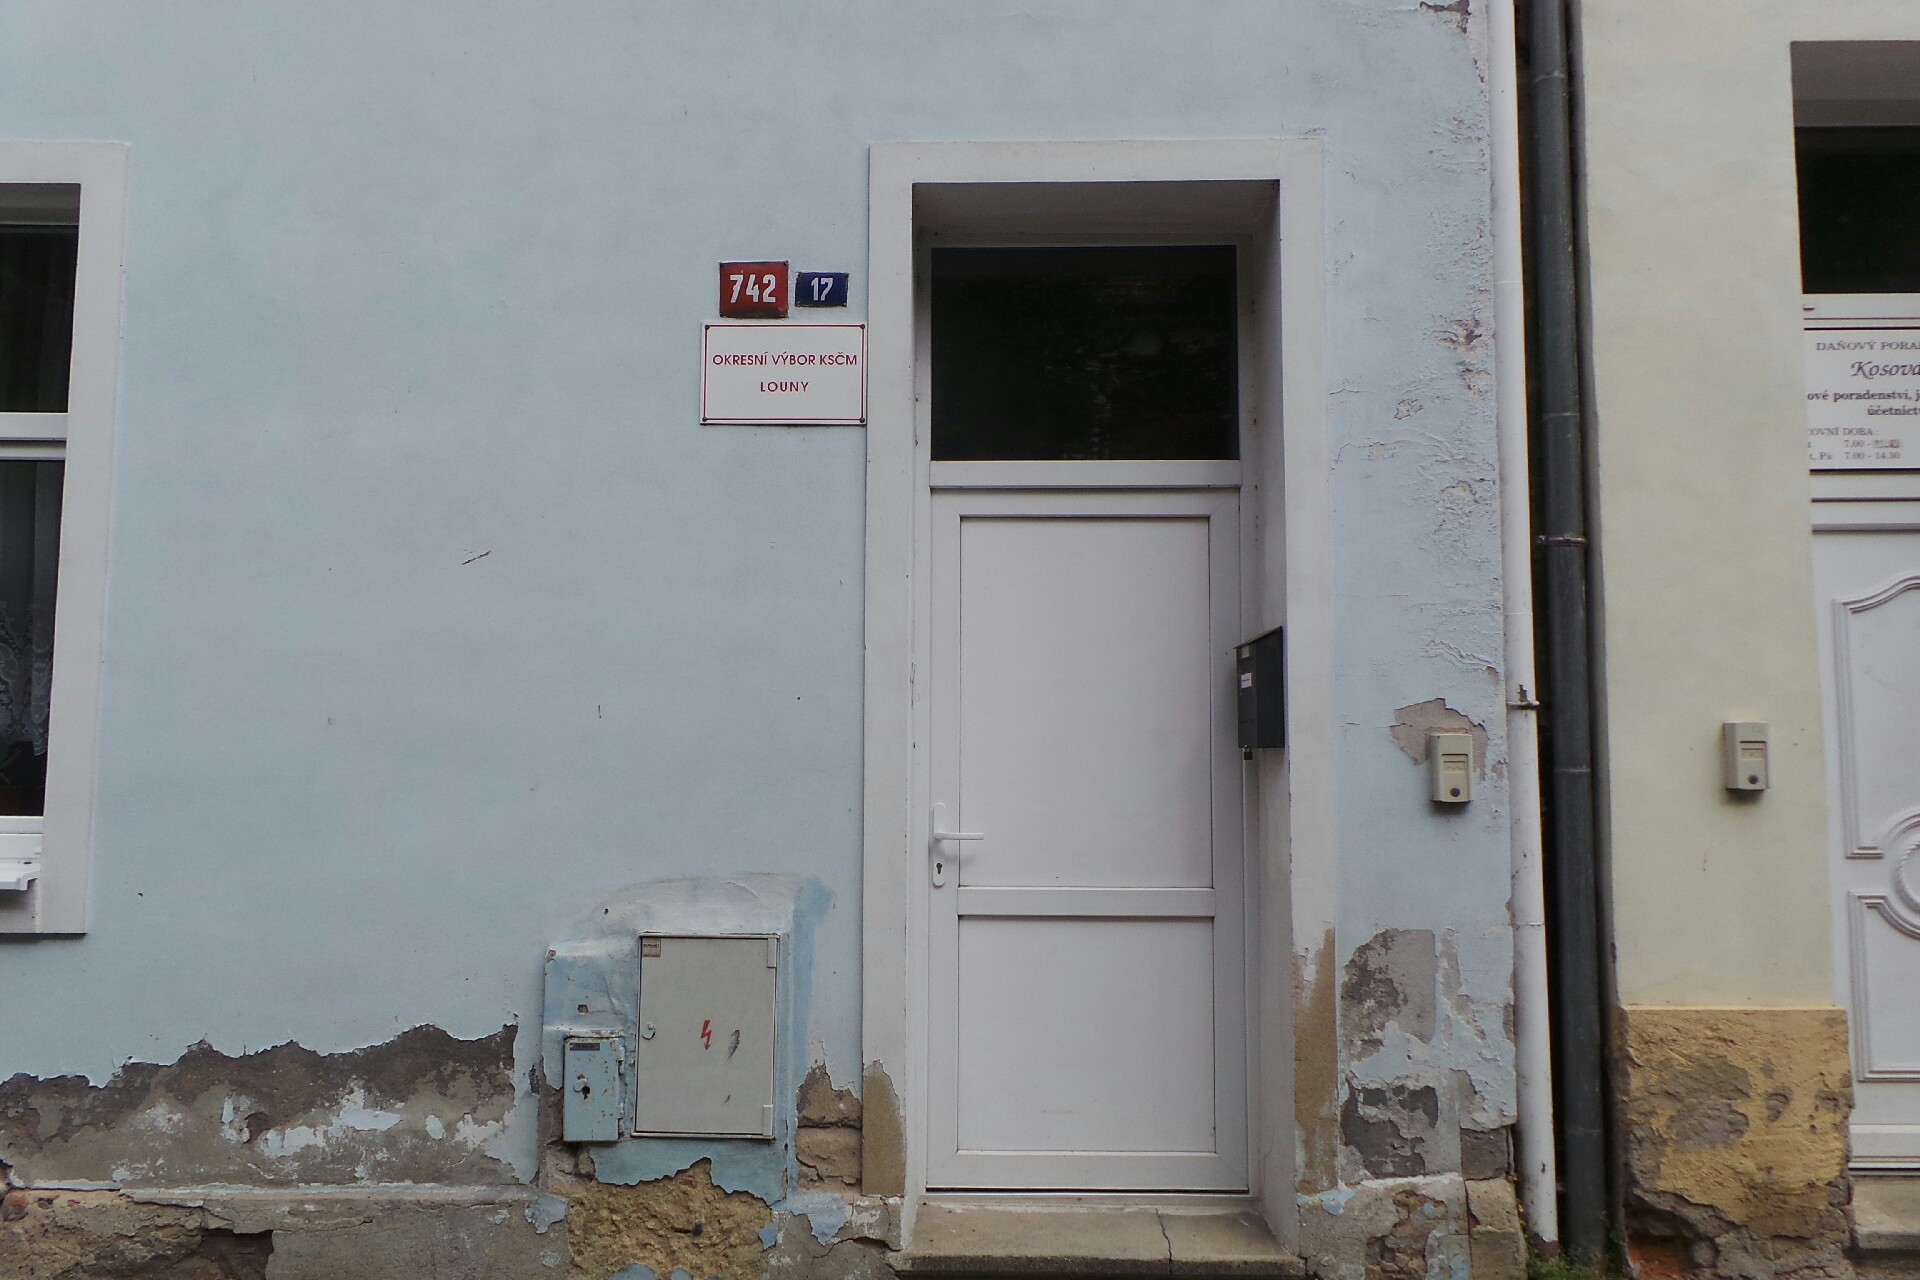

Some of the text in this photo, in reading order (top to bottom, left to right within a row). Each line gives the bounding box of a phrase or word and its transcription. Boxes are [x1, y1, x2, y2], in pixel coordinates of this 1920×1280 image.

[729, 274, 777, 304] 742
[810, 277, 834, 301] 17
[1816, 340, 1877, 351] DAŇOVÝ
[712, 351, 858, 366] OKRESNÍ VÝBOR KSČM
[760, 381, 810, 393] LOUNY
[1842, 427, 1873, 436] DOBA
